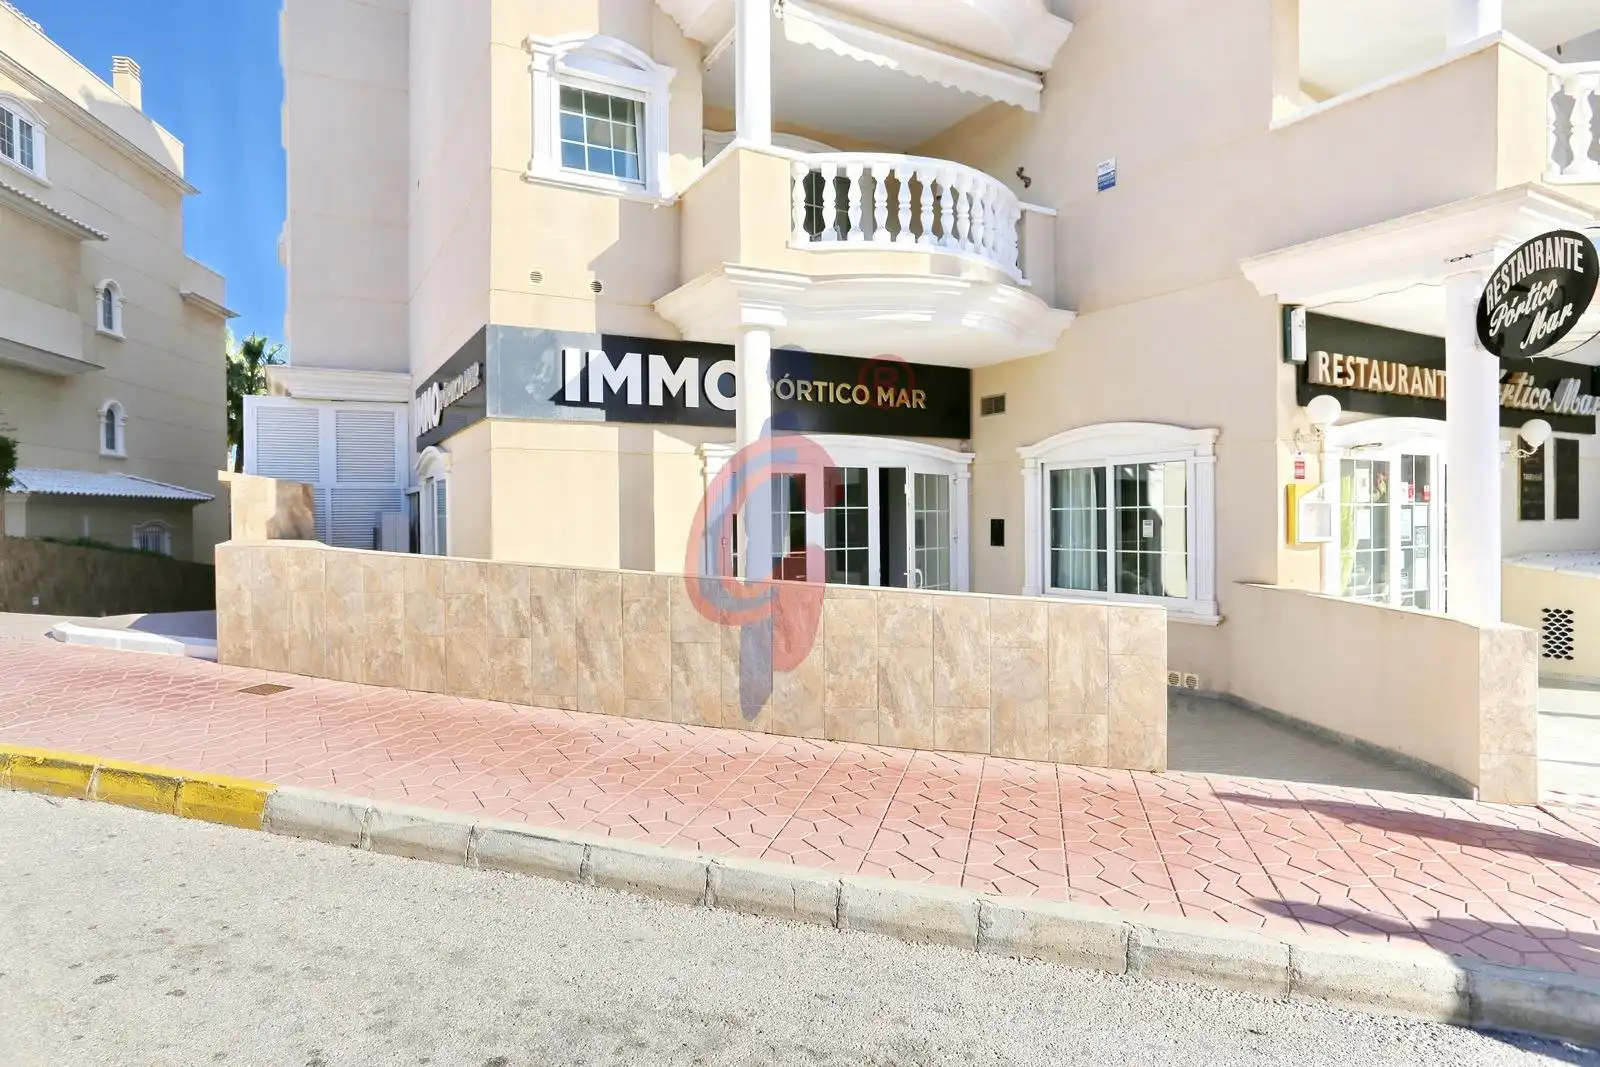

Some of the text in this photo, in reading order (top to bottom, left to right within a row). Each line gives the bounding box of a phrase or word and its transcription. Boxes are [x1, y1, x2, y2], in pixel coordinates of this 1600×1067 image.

[1486, 237, 1584, 316] RESTAURANTE
[1489, 279, 1558, 337] Pórtico
[1520, 303, 1573, 349] Mar
[565, 348, 927, 411] IMMO ÓRTICO MAR
[1317, 350, 1447, 399] RESTAURANT
[1500, 369, 1552, 411] rtico
